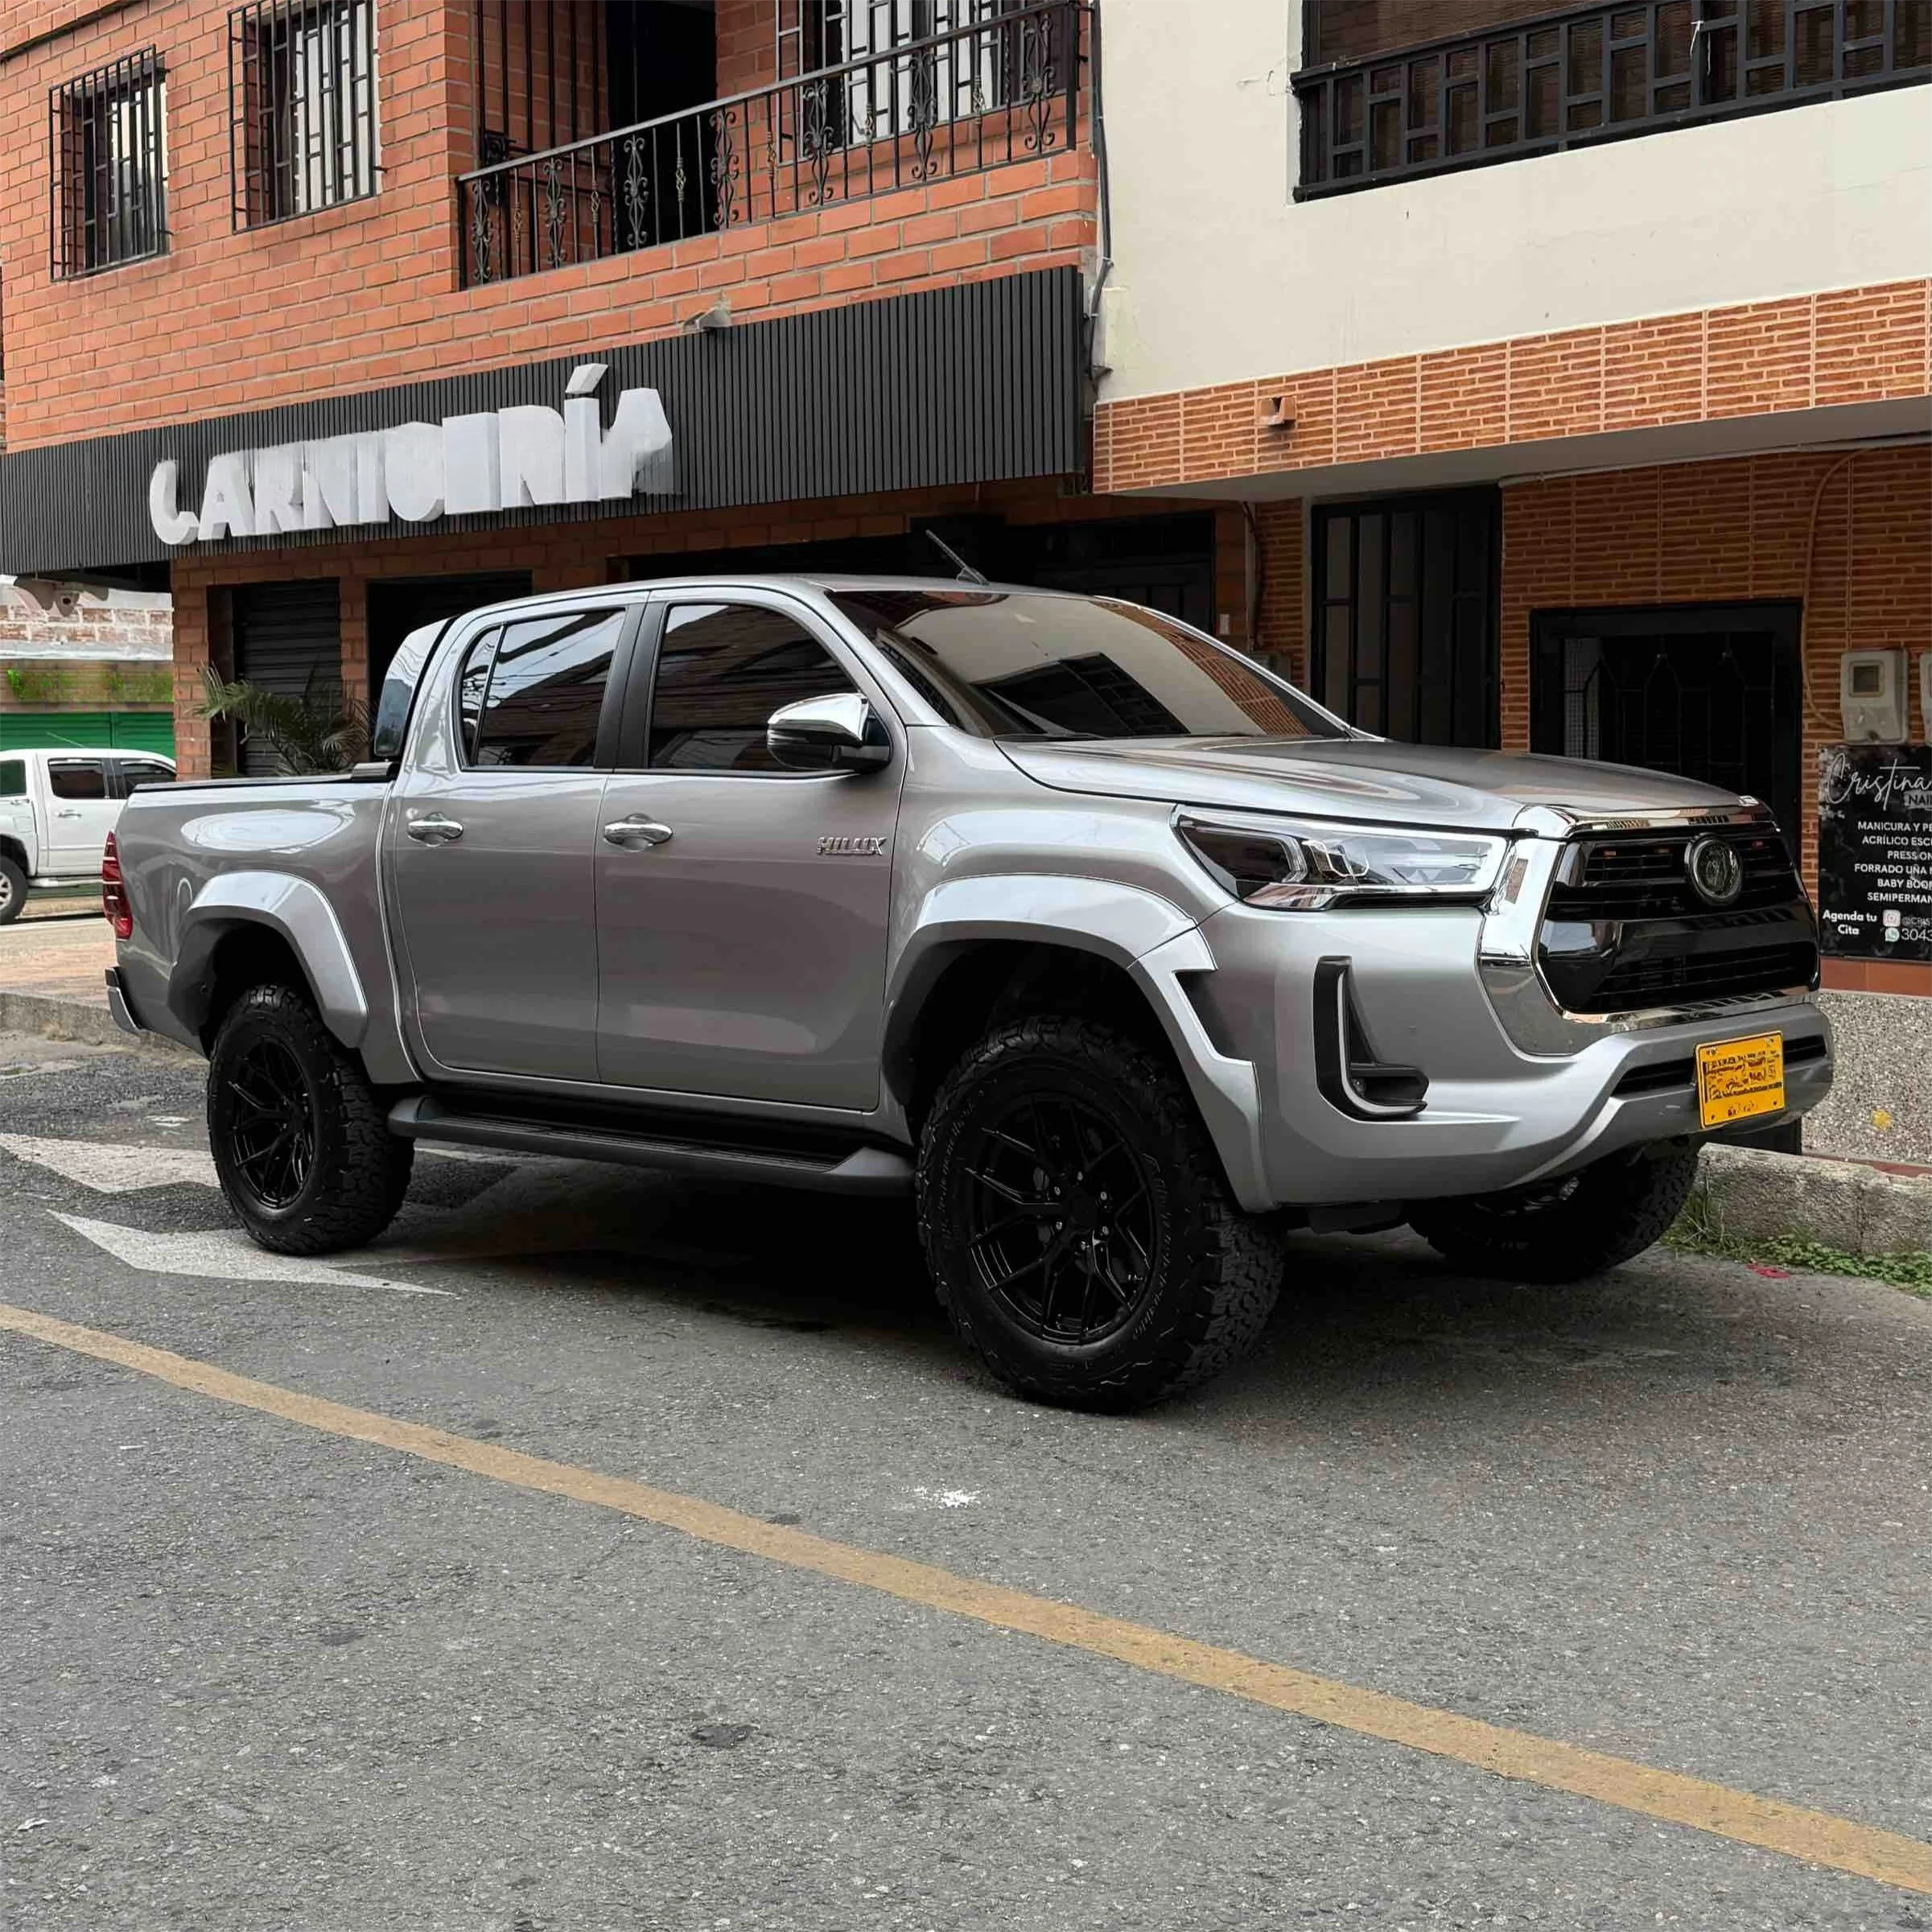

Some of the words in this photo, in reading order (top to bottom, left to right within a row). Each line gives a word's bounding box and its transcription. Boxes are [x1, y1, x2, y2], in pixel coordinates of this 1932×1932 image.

[1857, 821, 1912, 831] MANICURA
[1913, 822, 1921, 832] Y
[816, 837, 888, 855] HILUX
[1862, 834, 1909, 846] ACRÍLICO
[1911, 837, 1932, 847] ESC
[1887, 851, 1918, 860] PRESS
[1854, 863, 1904, 874] FORRADO
[1877, 878, 1905, 888] BABY
[1822, 909, 1864, 923] Agenda
[1866, 912, 1878, 922] tu
[1837, 924, 1860, 935] Cita
